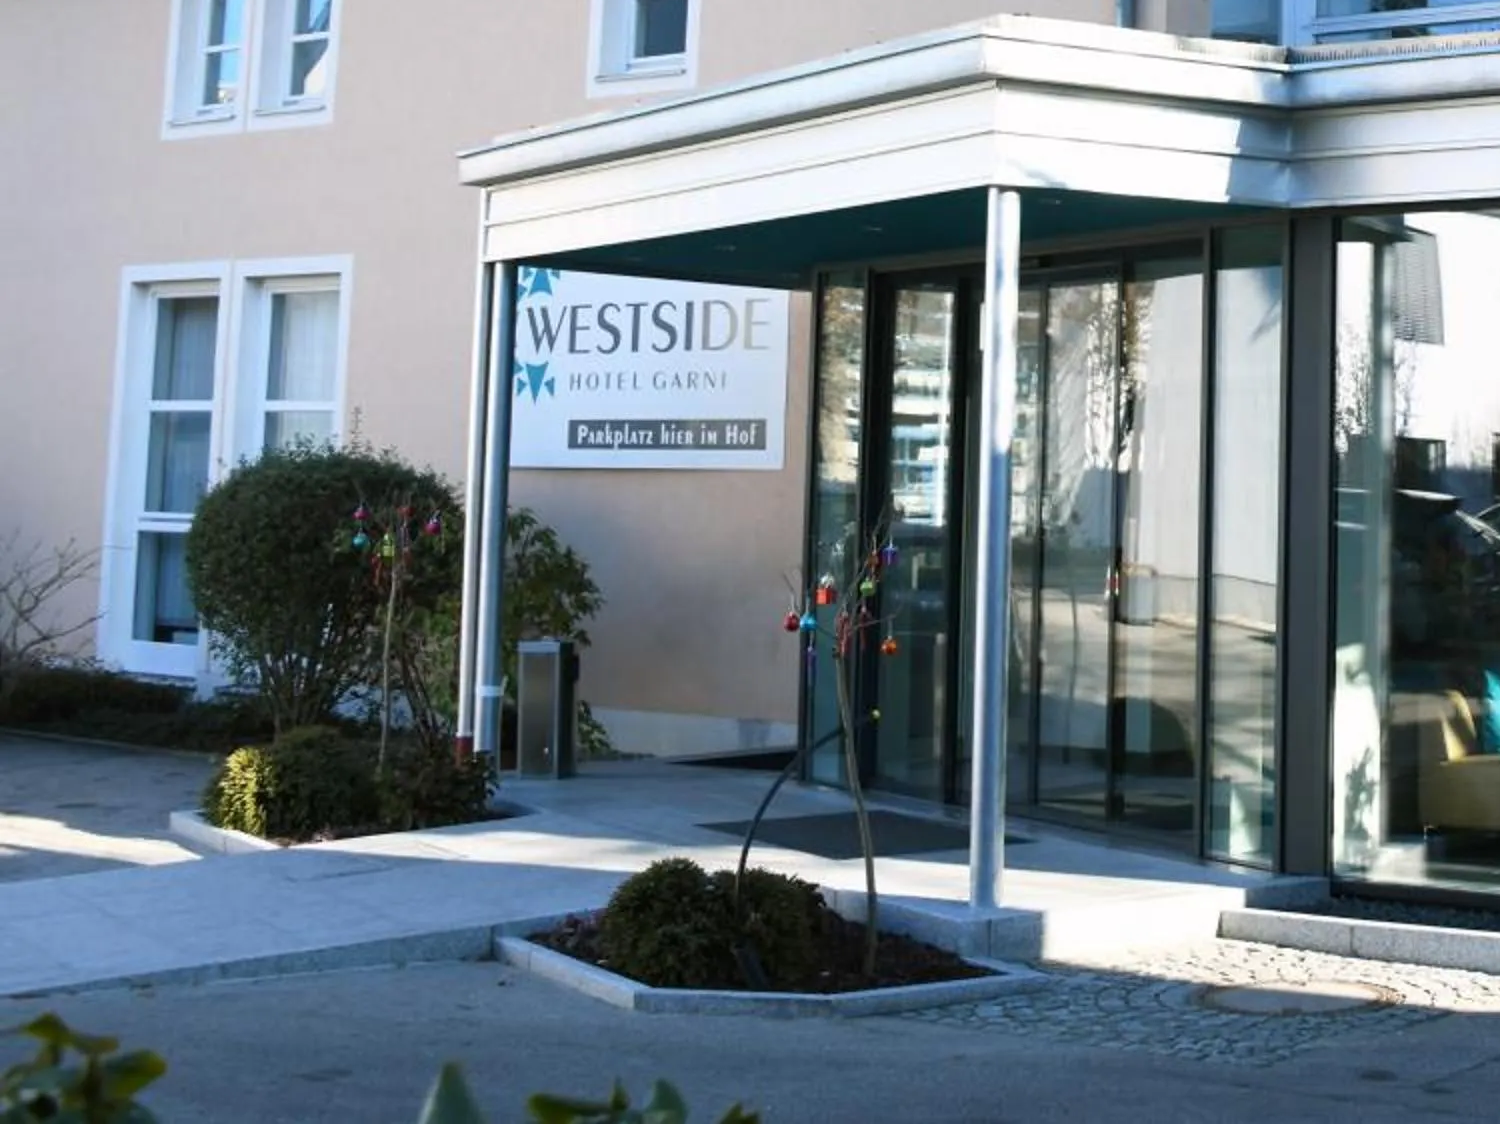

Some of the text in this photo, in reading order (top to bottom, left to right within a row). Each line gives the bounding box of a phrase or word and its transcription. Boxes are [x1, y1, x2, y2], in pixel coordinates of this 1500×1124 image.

[526, 298, 771, 355] WESTSIDE
[569, 370, 728, 391] HOTEL GARNI
[725, 423, 758, 445] Hof
